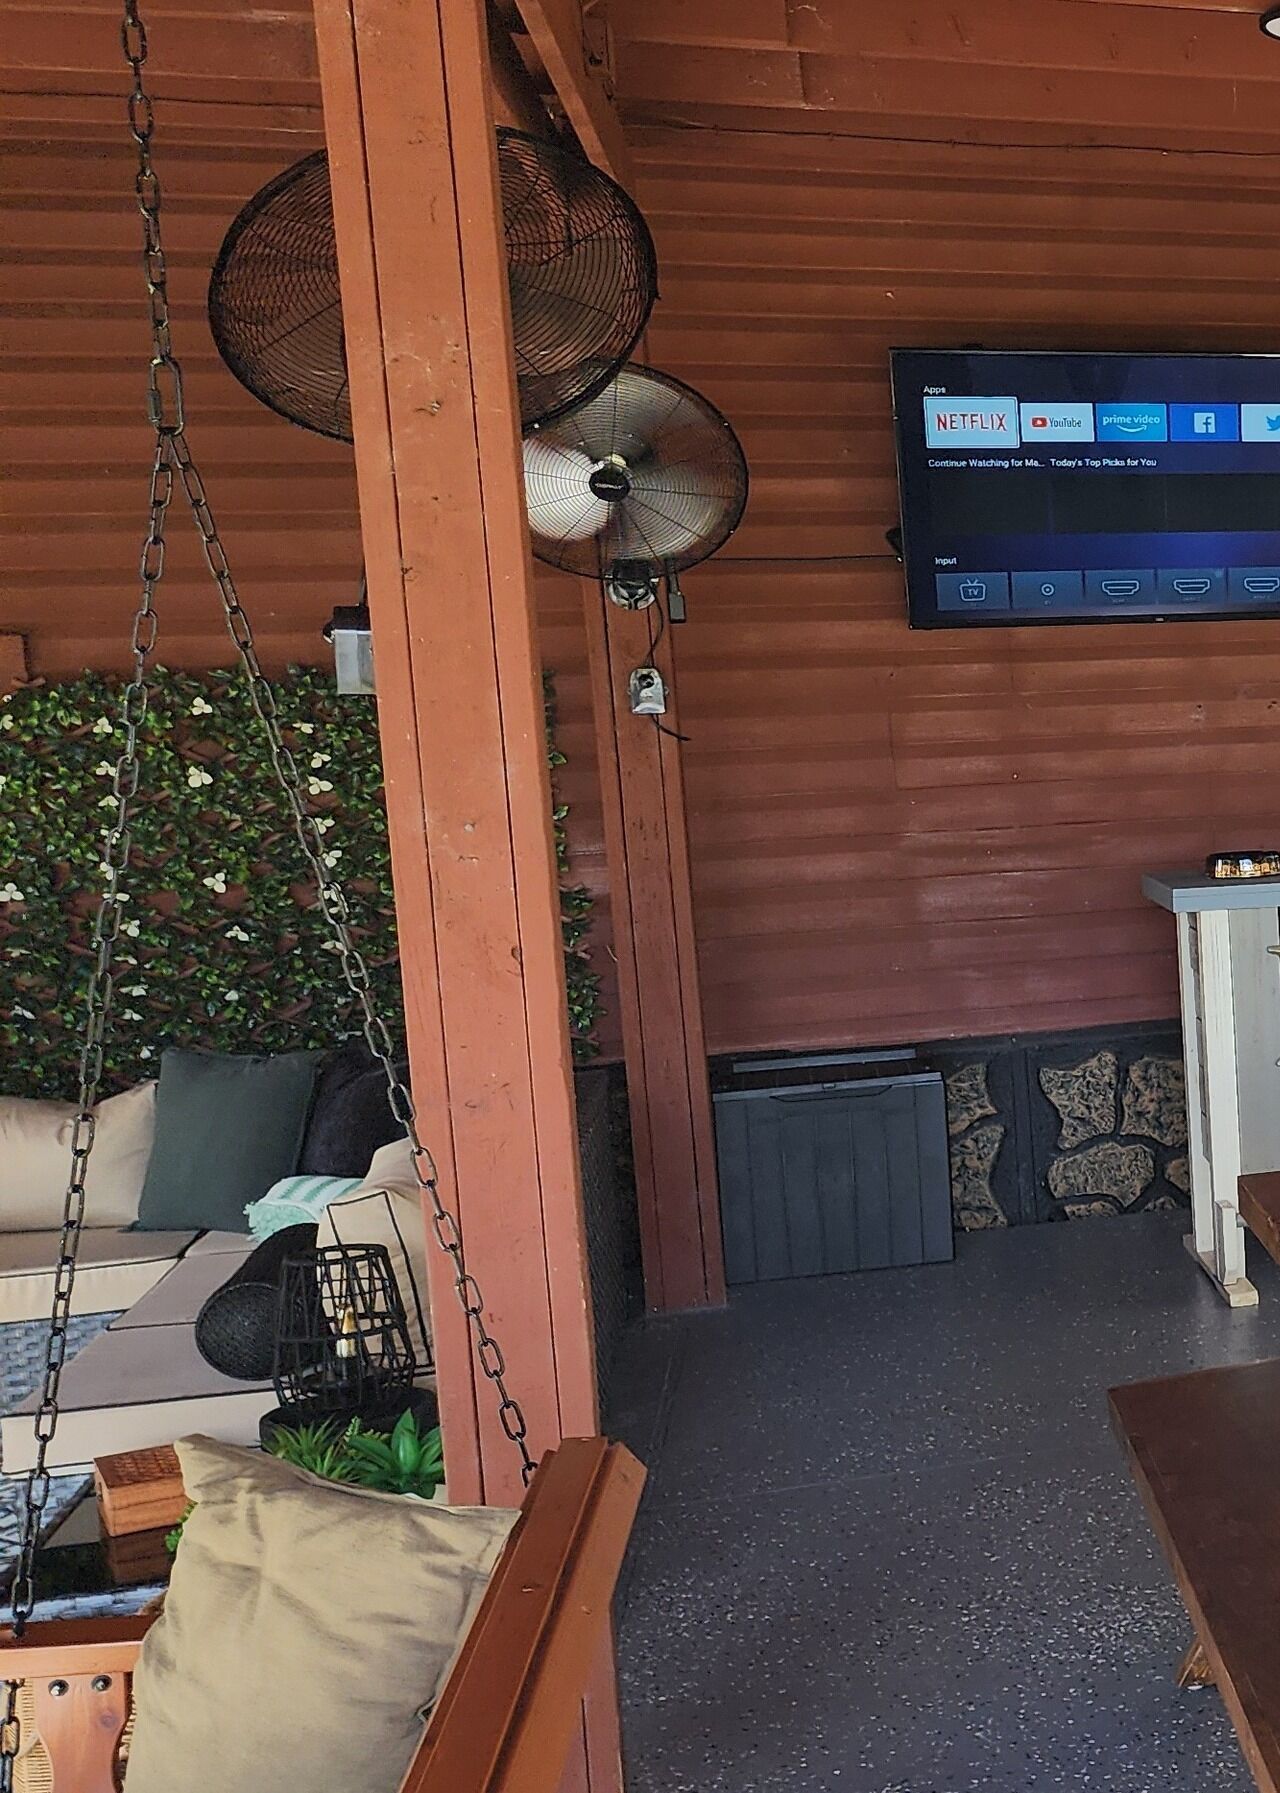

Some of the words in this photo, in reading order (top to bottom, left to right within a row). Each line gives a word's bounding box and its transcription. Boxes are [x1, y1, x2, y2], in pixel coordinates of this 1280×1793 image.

[923, 385, 946, 395] Apps
[936, 412, 1008, 432] NETFLIX
[1049, 417, 1082, 429] YouTube
[1102, 415, 1130, 426] prime
[1131, 414, 1160, 425] video
[928, 458, 967, 468] Continue
[969, 458, 1009, 470] Watching
[1011, 458, 1022, 468] for
[1050, 458, 1083, 470] Today's
[1085, 459, 1101, 470] Top
[1103, 458, 1125, 468] Picks
[1126, 458, 1139, 468] for
[1140, 458, 1157, 468] You
[935, 556, 957, 567] Input
[968, 588, 978, 596] TV
